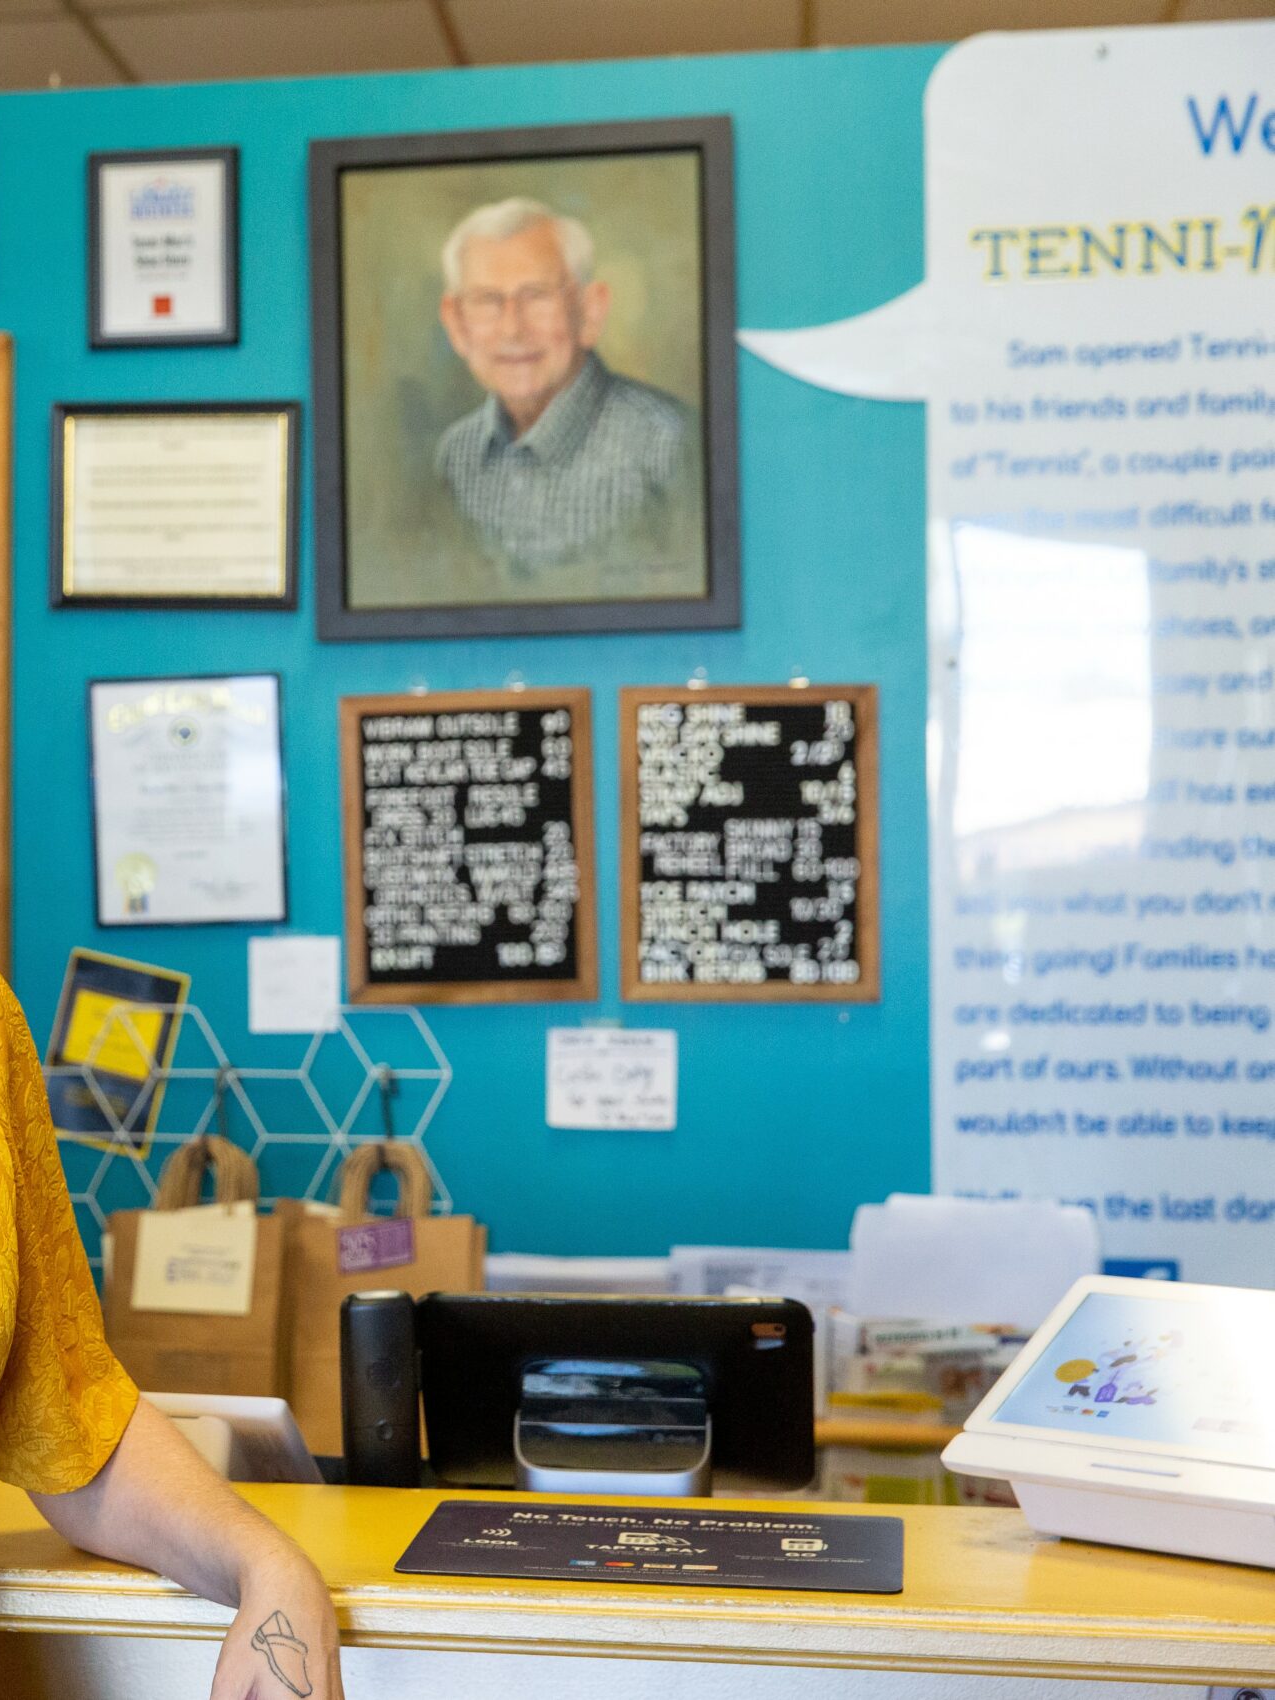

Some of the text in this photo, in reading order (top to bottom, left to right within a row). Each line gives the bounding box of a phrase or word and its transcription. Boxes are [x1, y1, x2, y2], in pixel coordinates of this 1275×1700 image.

[1075, 336, 1181, 370] opened
[1135, 391, 1190, 417] and
[1009, 1000, 1148, 1025] dedicated
[1192, 1001, 1270, 1032] being
[513, 1512, 549, 1520] No
[653, 1518, 691, 1526] No
[463, 1538, 520, 1546] LOOK
